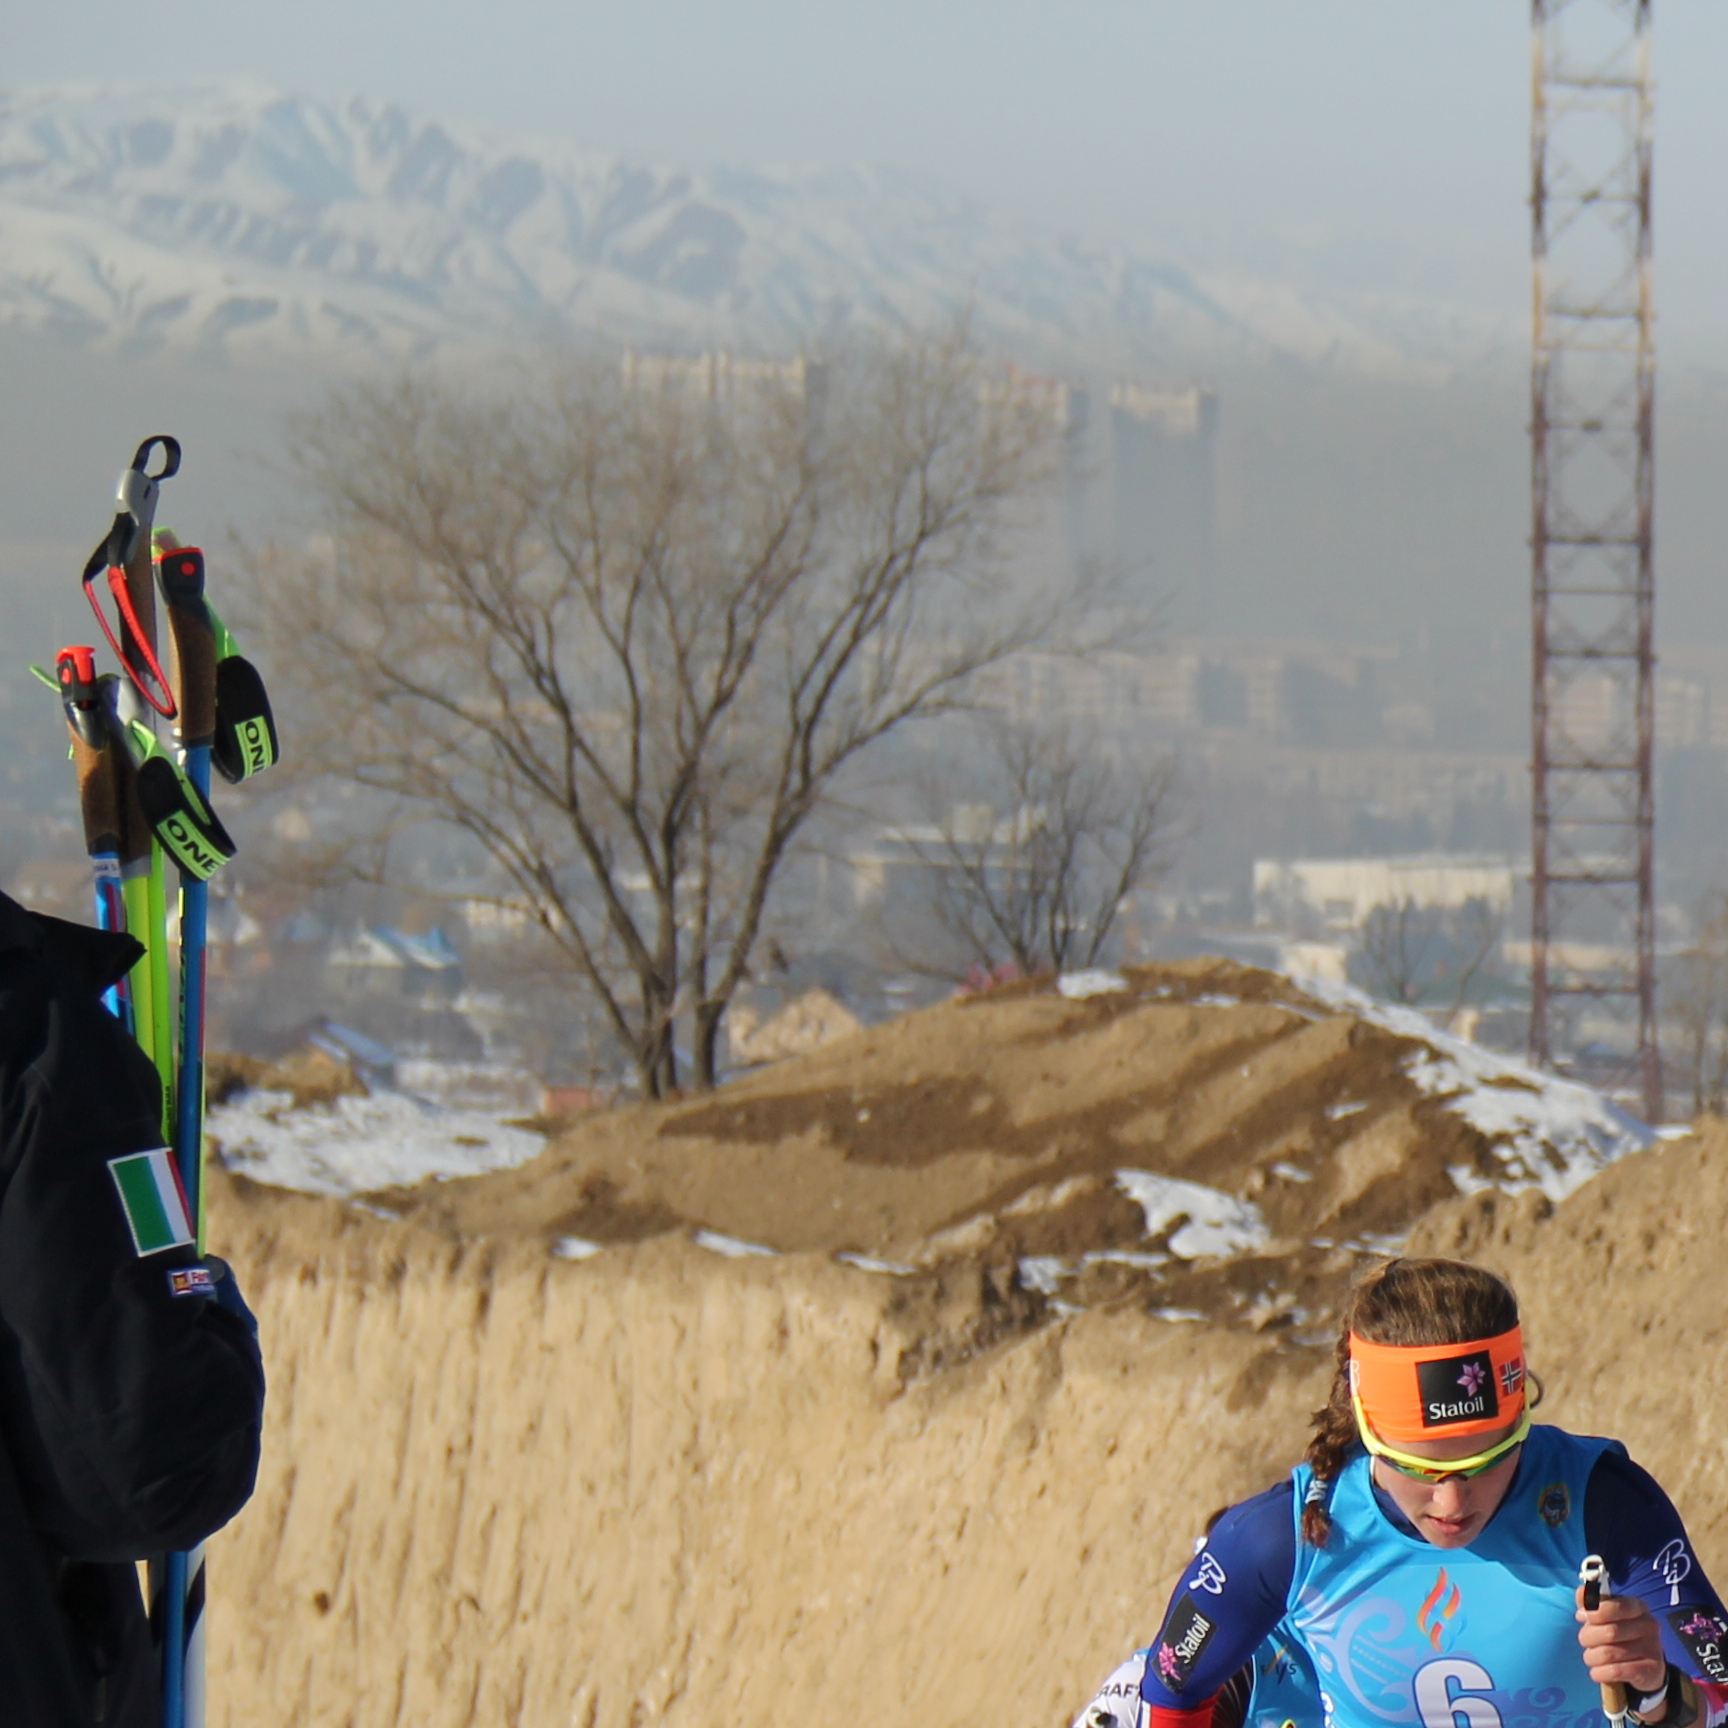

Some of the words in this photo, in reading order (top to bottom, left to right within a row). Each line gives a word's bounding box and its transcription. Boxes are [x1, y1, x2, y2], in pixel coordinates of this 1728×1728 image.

[167, 818, 218, 874] ONE
[1429, 1395, 1485, 1420] Statoil
[1174, 1612, 1212, 1665] Statoil
